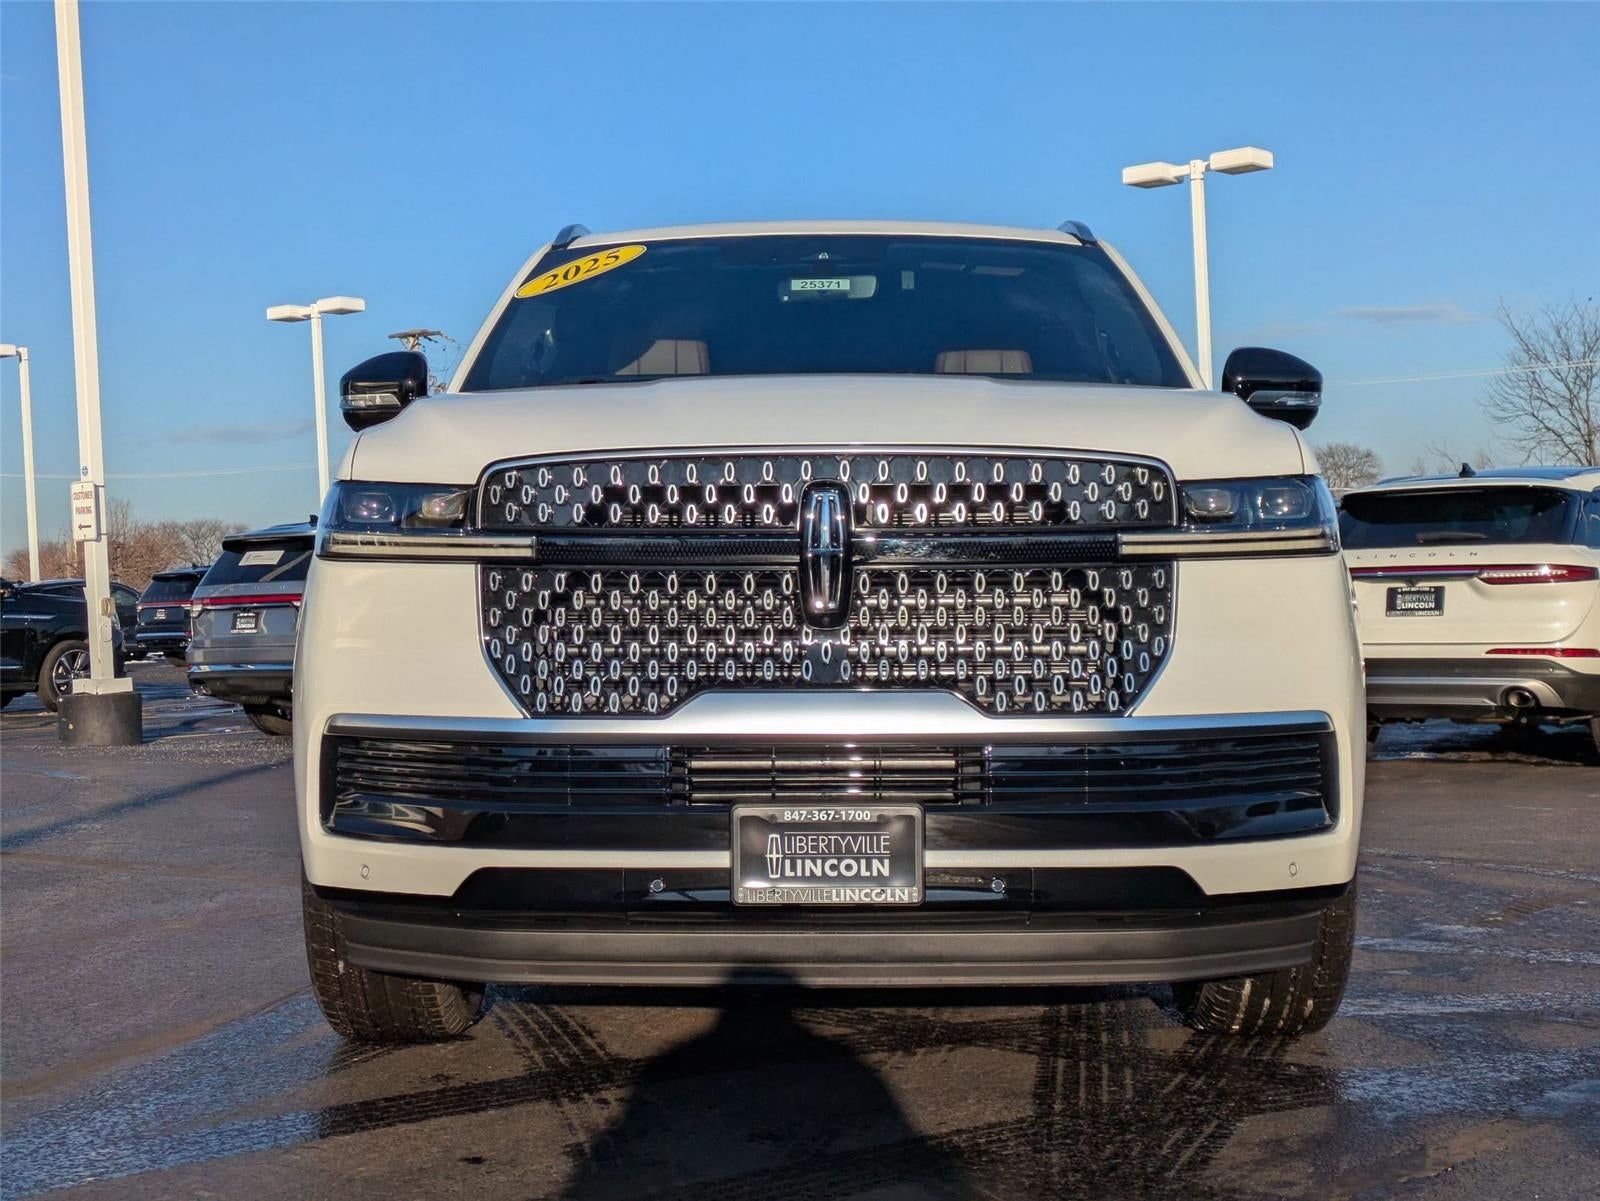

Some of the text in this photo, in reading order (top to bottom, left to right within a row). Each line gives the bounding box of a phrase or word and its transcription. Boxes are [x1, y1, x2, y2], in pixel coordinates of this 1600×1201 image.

[542, 249, 620, 291] 2025
[800, 280, 841, 289] 25371
[1356, 552, 1478, 560] LINCOLN
[783, 810, 871, 821] 847-367-1700
[784, 835, 890, 854] LIBERTYVILLE
[784, 858, 890, 877] LINCOLN
